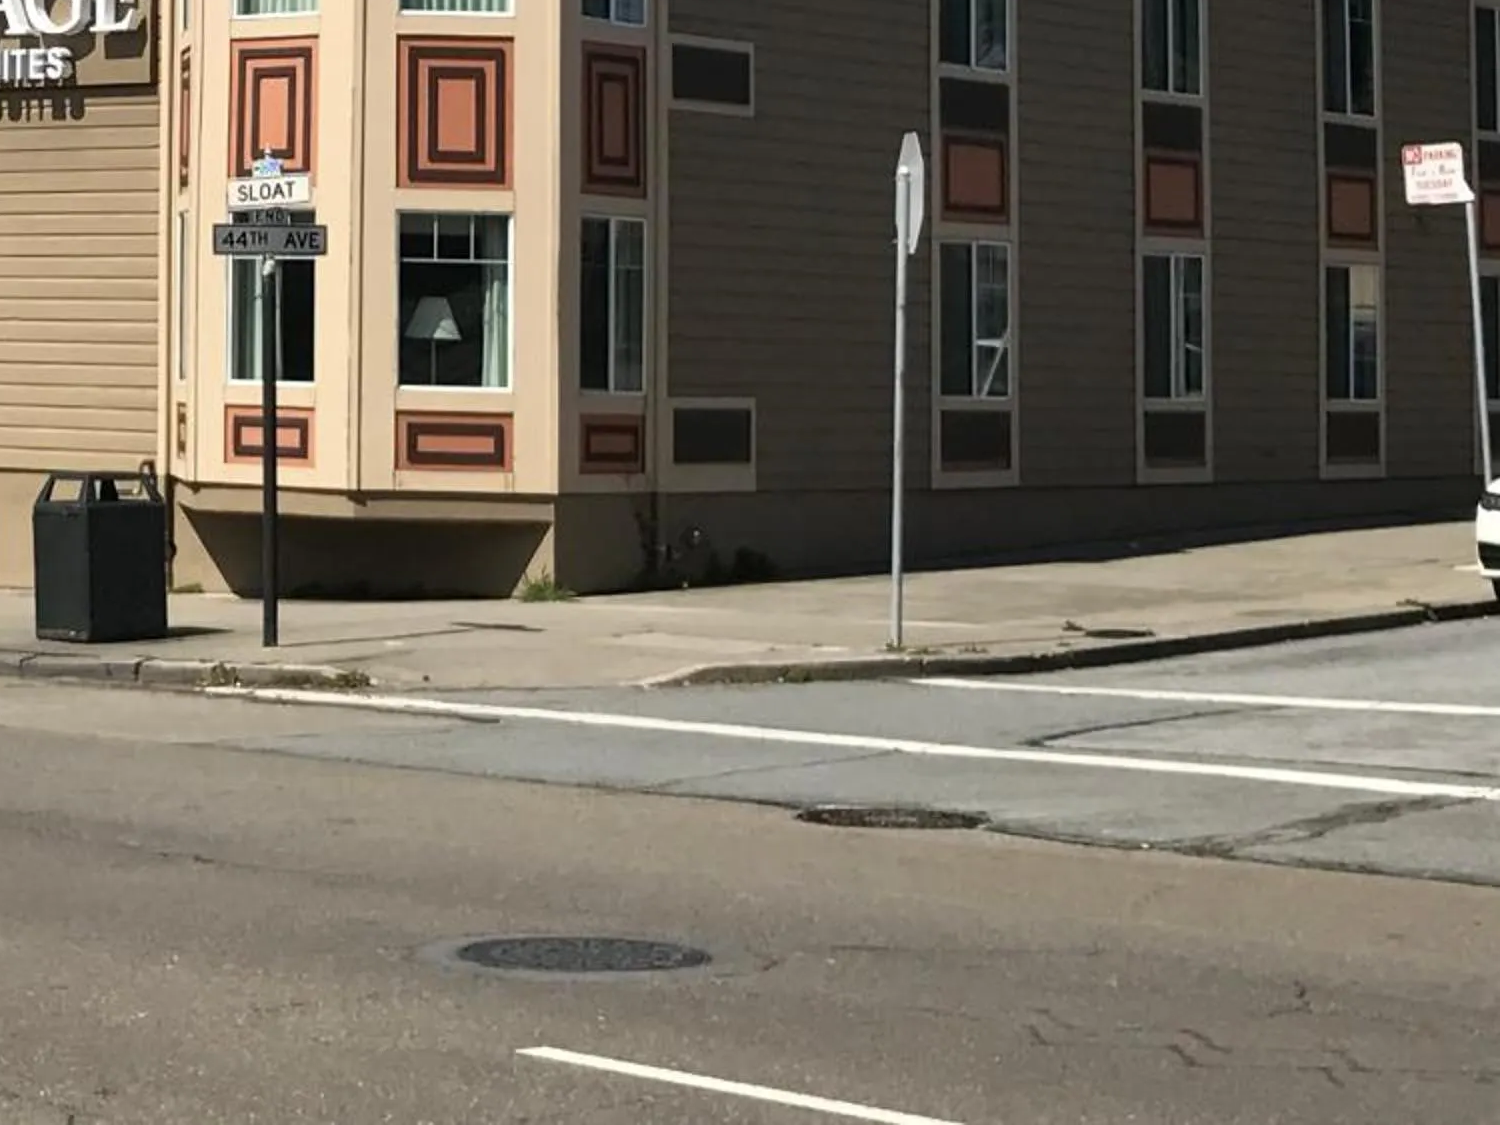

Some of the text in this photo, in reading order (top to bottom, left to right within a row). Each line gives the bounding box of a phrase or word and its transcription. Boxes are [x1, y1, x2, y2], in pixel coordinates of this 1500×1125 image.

[237, 180, 296, 203] SLOAT
[220, 230, 320, 250] 44TH AVE
